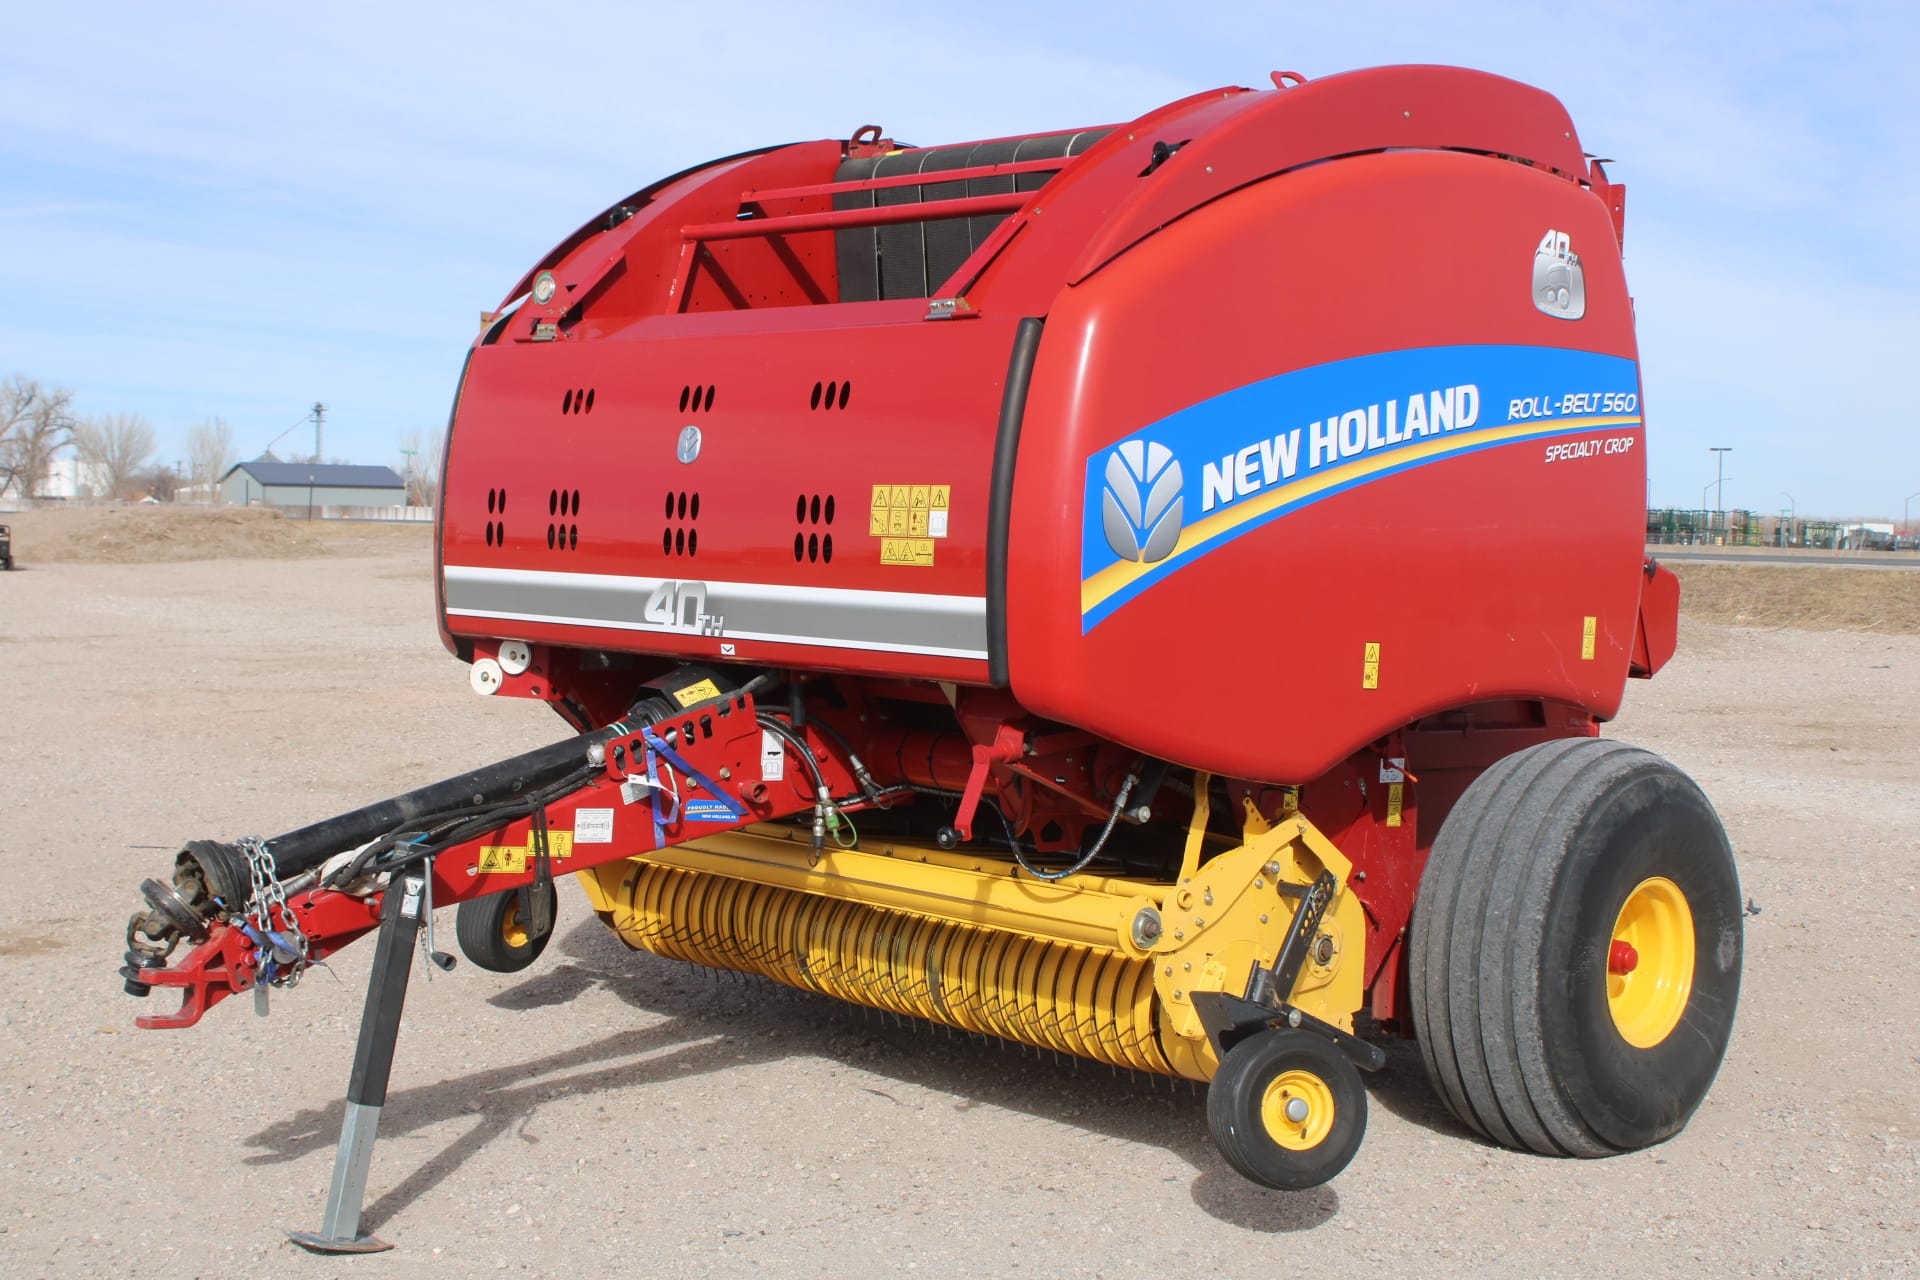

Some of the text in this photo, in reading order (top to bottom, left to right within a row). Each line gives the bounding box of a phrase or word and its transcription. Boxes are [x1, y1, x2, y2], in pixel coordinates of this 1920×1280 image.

[1602, 392, 1637, 413] 560
[1202, 384, 1480, 512] NEW HOLLAND
[1544, 437, 1634, 463] SPECIALTY CROP
